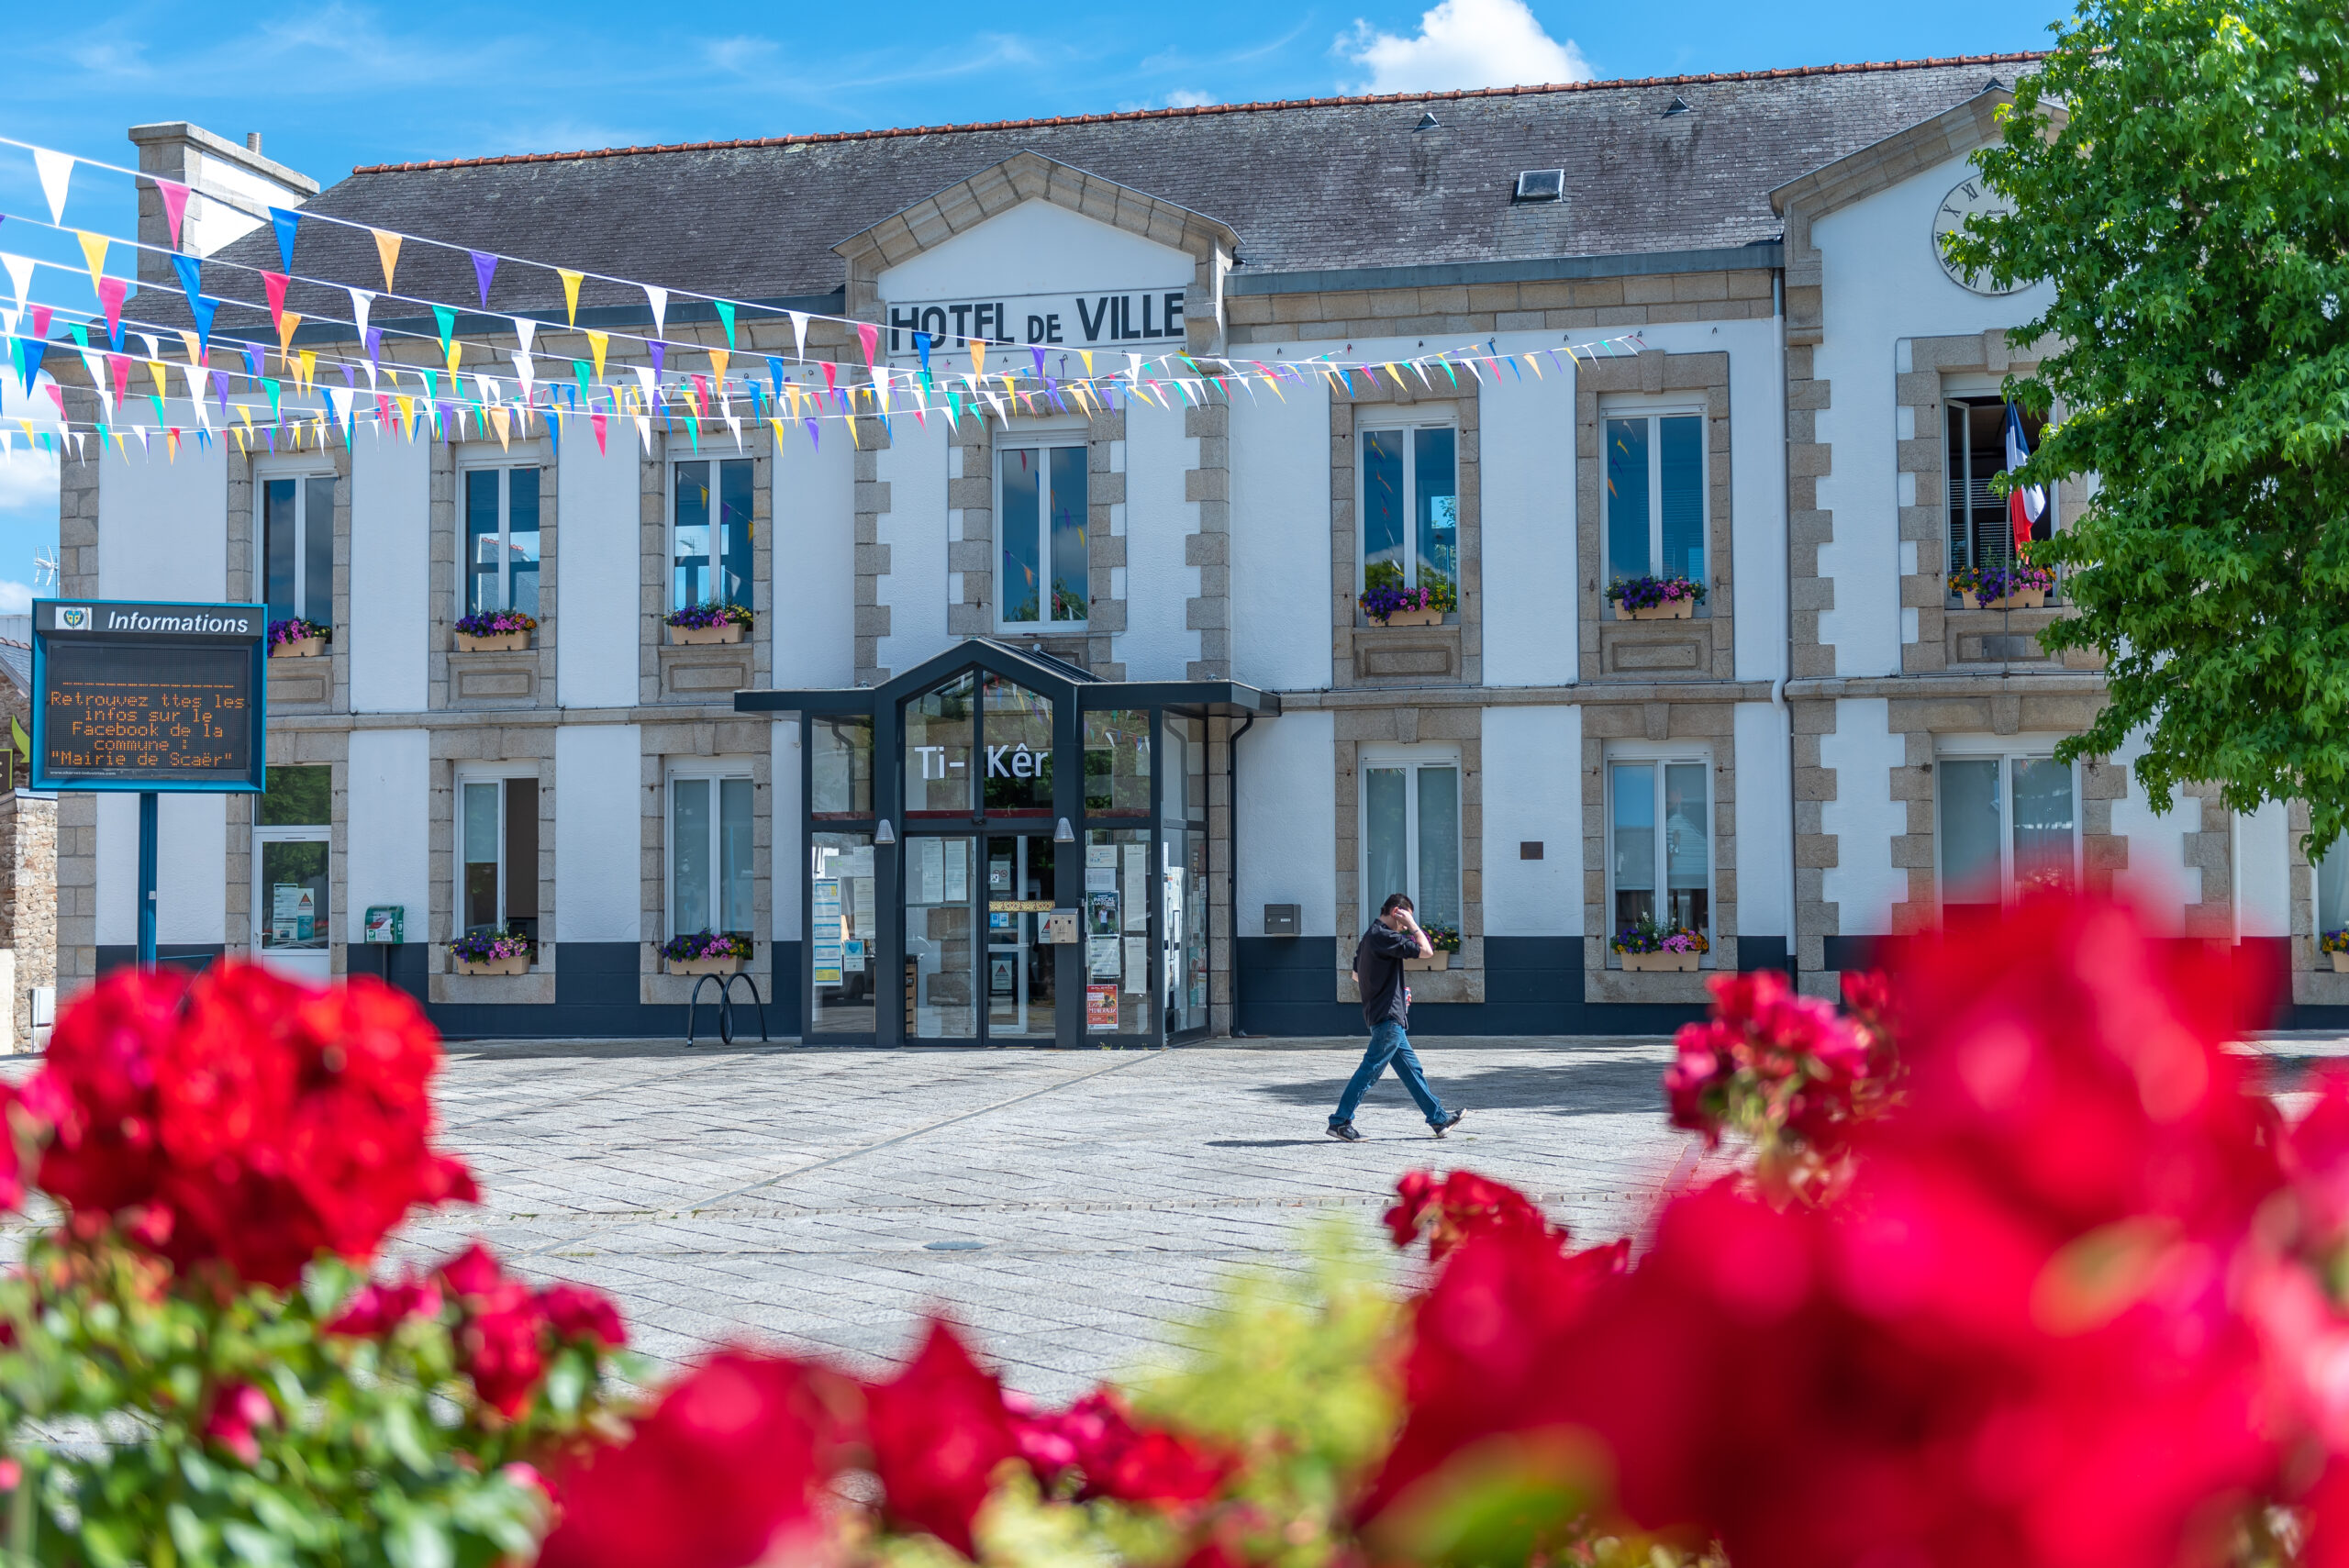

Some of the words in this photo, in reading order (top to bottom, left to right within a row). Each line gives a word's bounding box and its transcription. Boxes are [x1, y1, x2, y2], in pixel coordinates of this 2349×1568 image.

[891, 302, 1015, 351] HOTEL
[1027, 314, 1063, 345] DE
[1075, 293, 1185, 342] VILLE
[108, 611, 249, 633] Informations
[51, 691, 149, 707] Retrouvez
[161, 693, 202, 708] ttes
[215, 694, 245, 708] les
[85, 706, 138, 721] infos
[149, 711, 181, 722] sur
[193, 708, 213, 723] le
[72, 721, 159, 737] Facebook
[170, 722, 192, 737] de
[204, 723, 223, 738] la
[94, 740, 170, 751] commune
[51, 751, 126, 766] "Mairie
[138, 751, 159, 766] de
[170, 751, 232, 768] Scaër"
[987, 742, 1049, 779] Kêr
